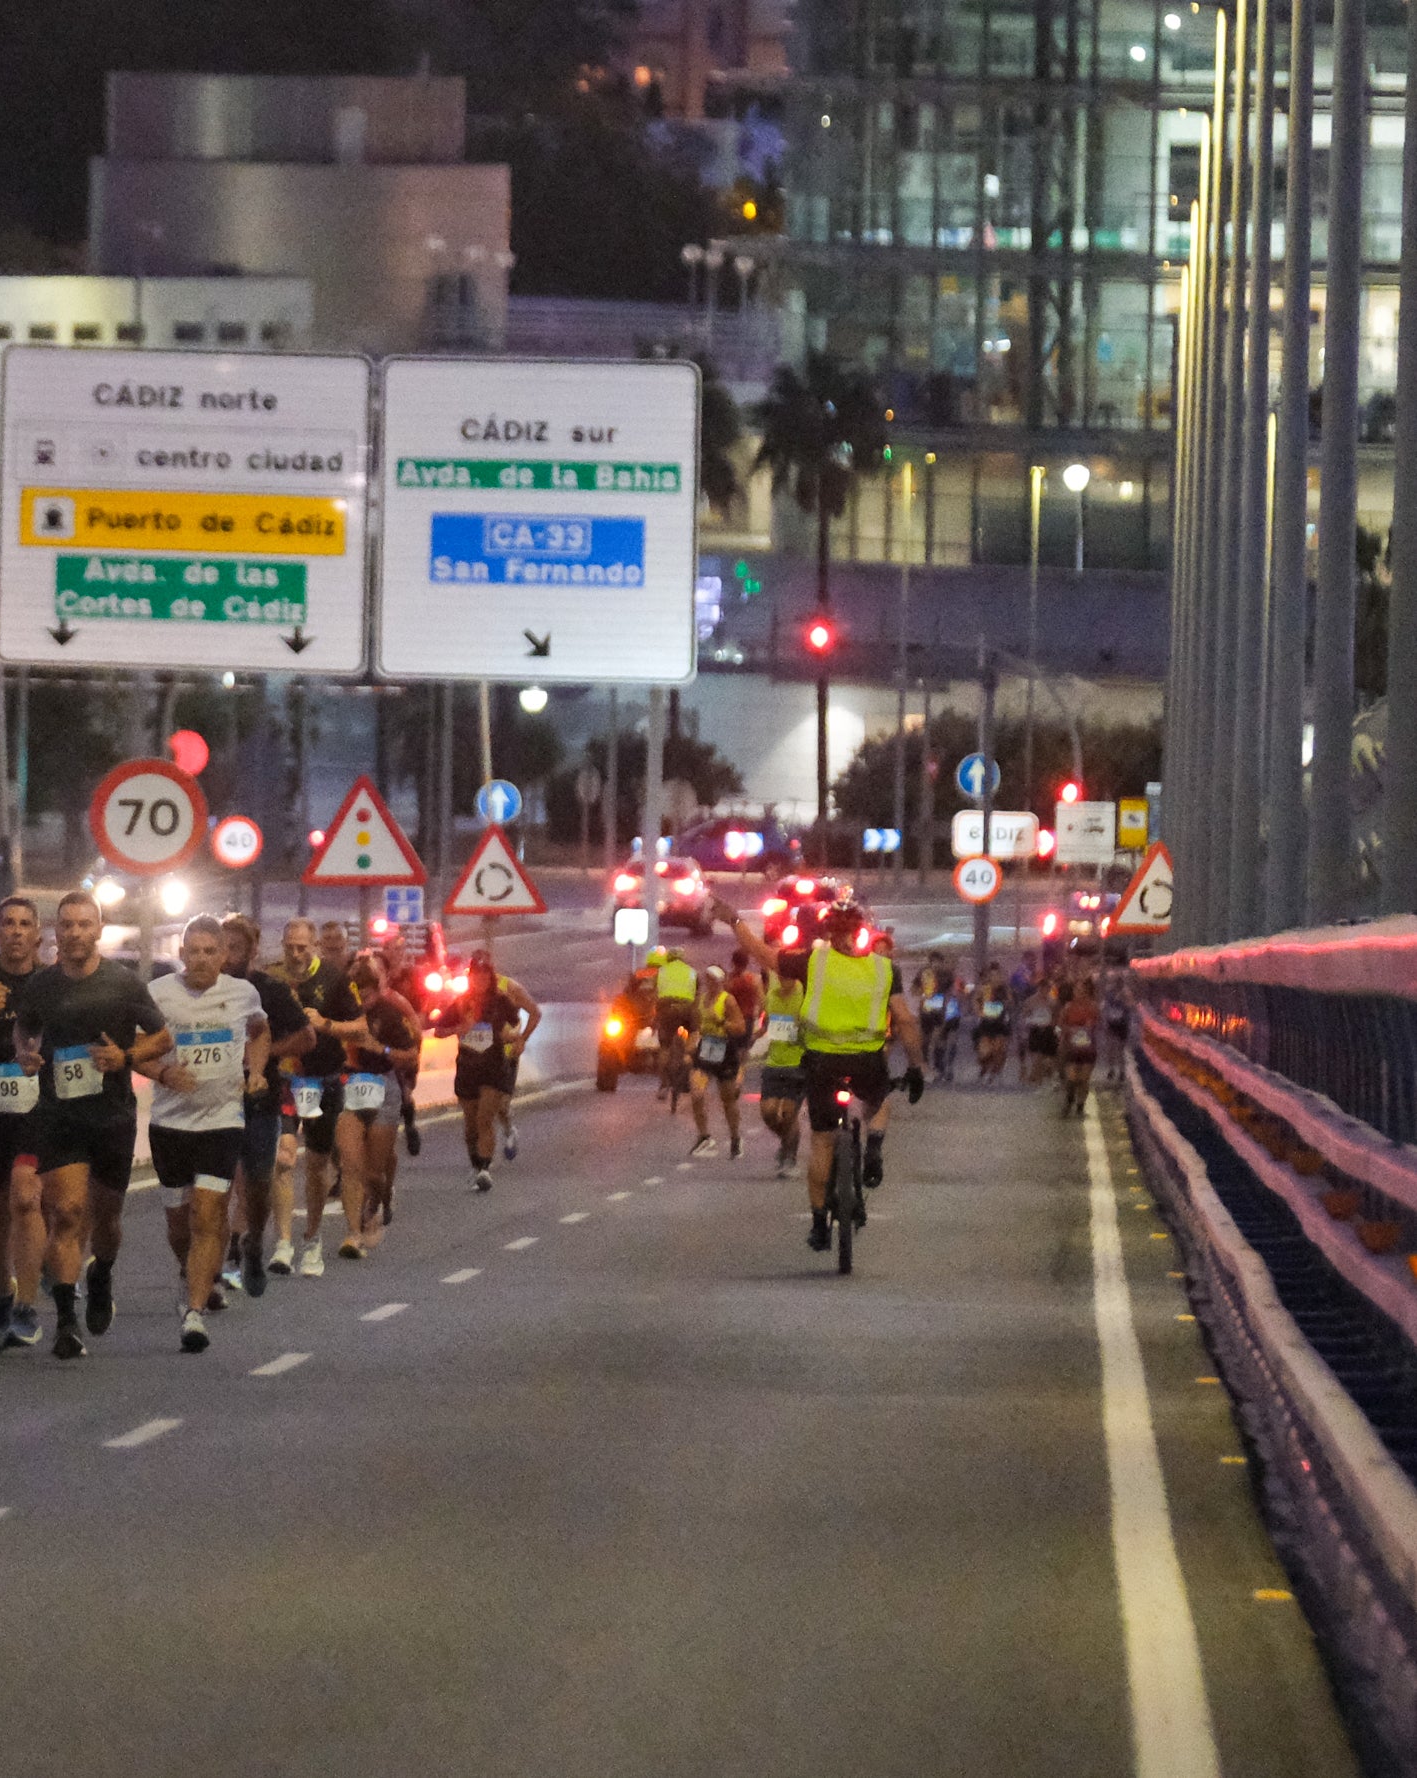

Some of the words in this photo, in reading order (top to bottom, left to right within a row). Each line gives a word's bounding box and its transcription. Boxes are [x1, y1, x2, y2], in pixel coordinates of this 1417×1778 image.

[200, 387, 279, 411] norte
[460, 411, 549, 442] CÁDIZ
[571, 423, 617, 444] sur
[136, 446, 233, 470] centro
[246, 448, 343, 473] ciudad
[400, 460, 481, 486] Avda.
[498, 463, 534, 486] de
[550, 464, 578, 488] la
[86, 506, 181, 531] Puerto
[200, 513, 234, 533] de
[492, 522, 584, 548] CA-33
[84, 556, 166, 584] Avda.
[184, 561, 220, 586] de
[236, 560, 280, 588] las
[434, 556, 489, 579] San
[505, 558, 642, 584] Fernando
[57, 589, 152, 615] Cortes
[170, 597, 206, 618] de
[118, 798, 180, 837] 70
[225, 832, 254, 849] 40
[969, 825, 1025, 842] CDIZ
[965, 868, 993, 887] 40
[193, 1046, 221, 1065] 276
[64, 1063, 83, 1082] 58
[0, 1080, 19, 1098] 98
